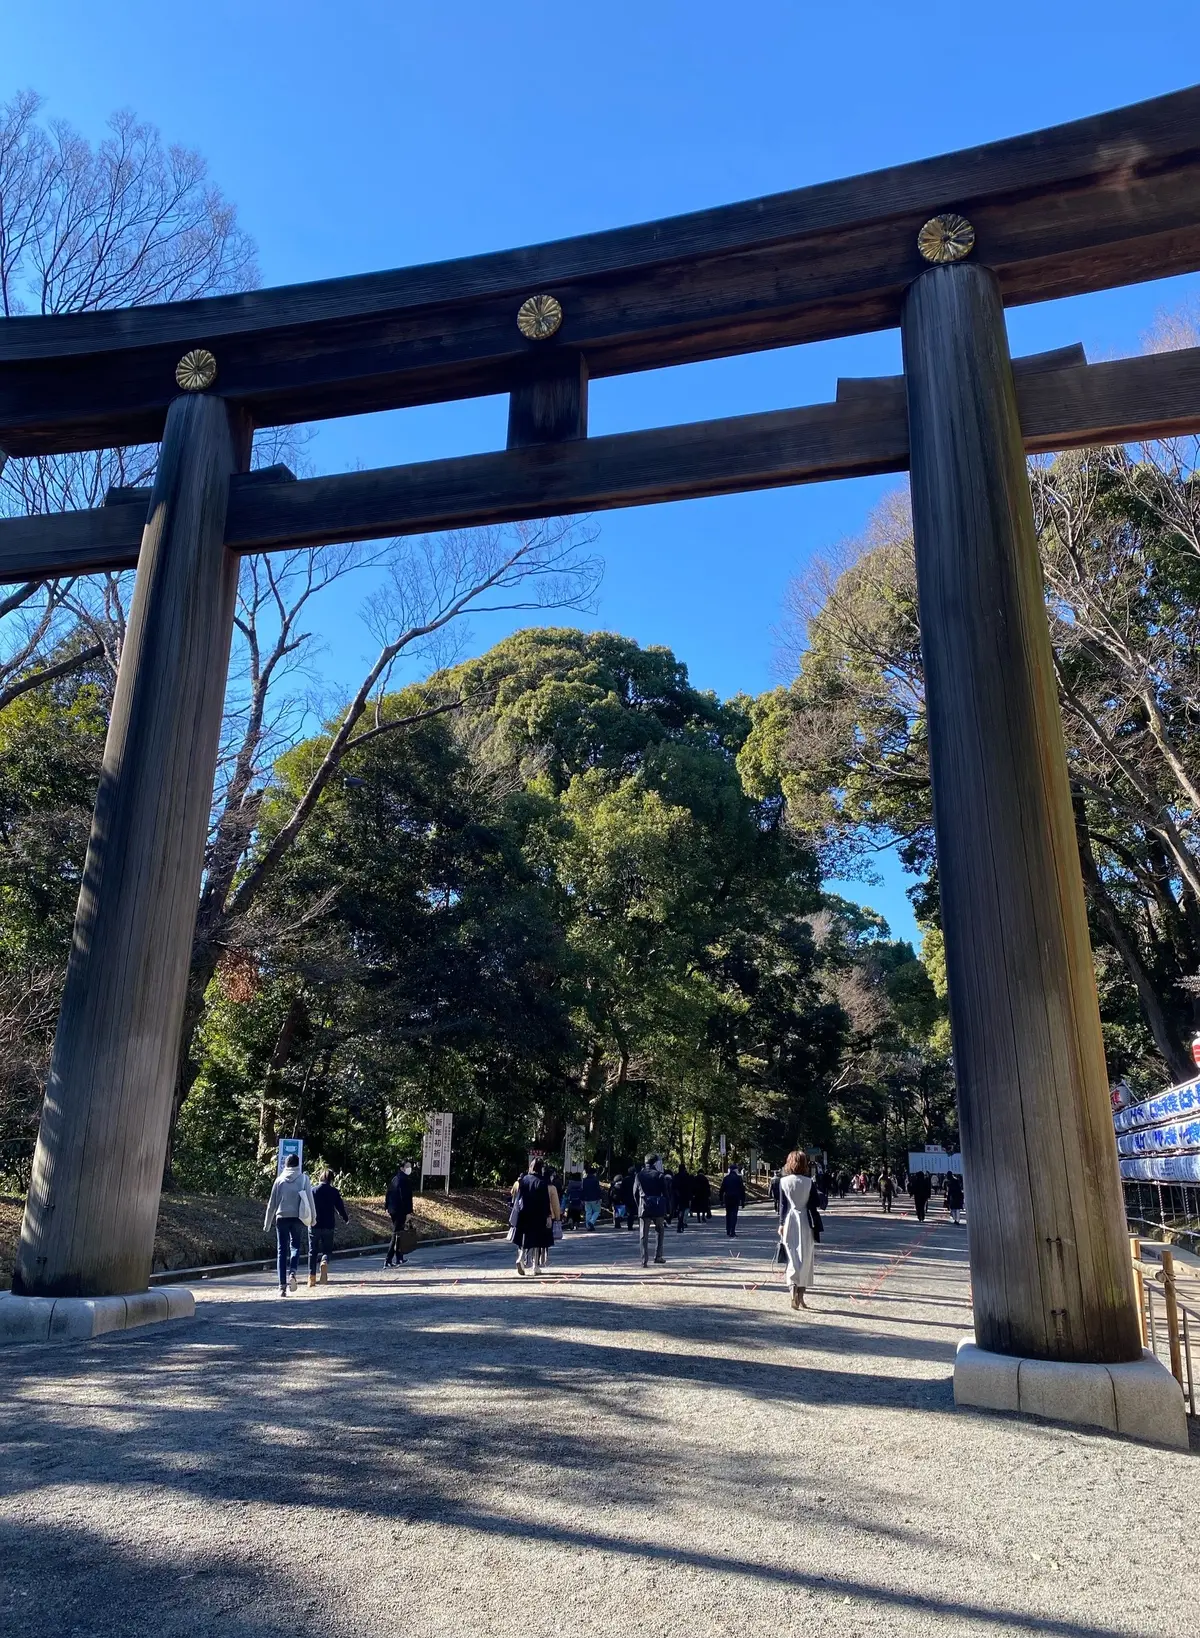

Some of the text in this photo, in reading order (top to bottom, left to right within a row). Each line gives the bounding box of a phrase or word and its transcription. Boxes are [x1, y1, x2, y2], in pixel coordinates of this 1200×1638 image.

[433, 1118, 442, 1168] 新年初祈願
